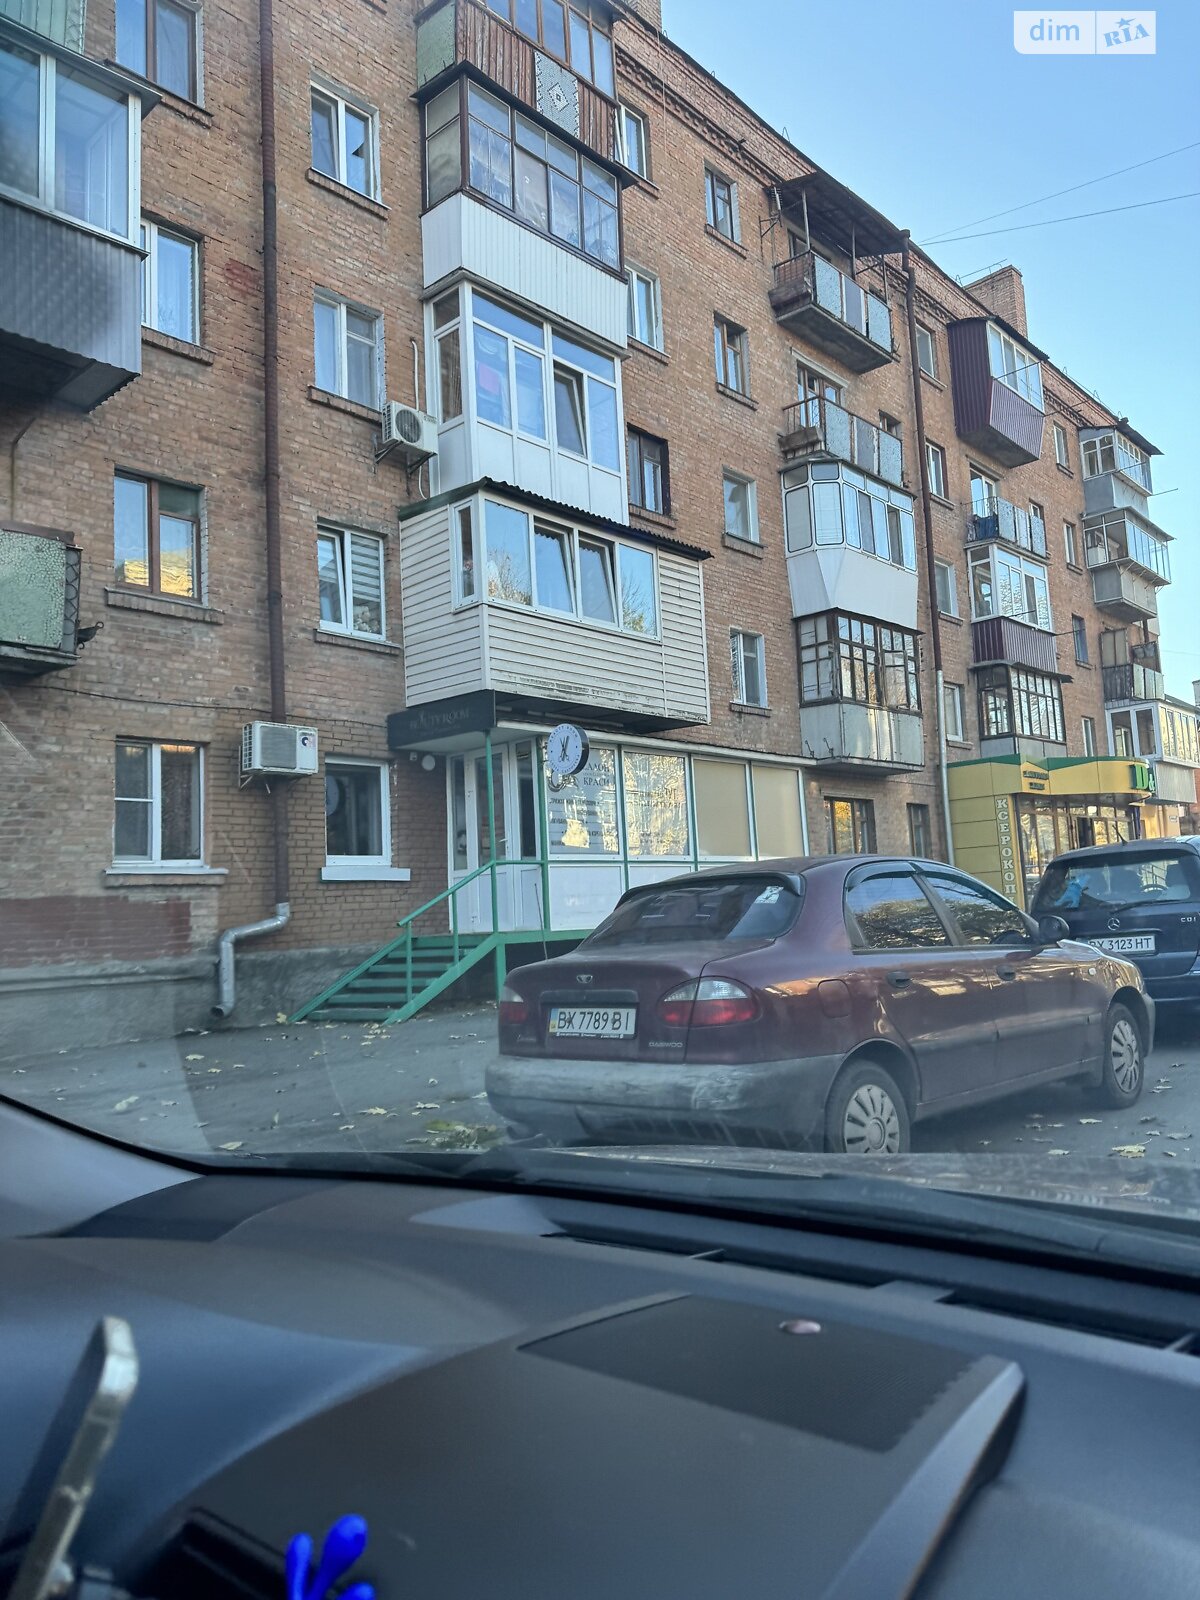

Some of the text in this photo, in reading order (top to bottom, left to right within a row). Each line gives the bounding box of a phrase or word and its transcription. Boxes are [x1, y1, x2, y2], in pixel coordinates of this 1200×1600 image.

[584, 762, 610, 772] АЛОН
[583, 777, 610, 787] КРАСИ
[1108, 938, 1133, 950] 3123
[1135, 937, 1152, 949] HT
[557, 1010, 630, 1031] BX 7789 BI
